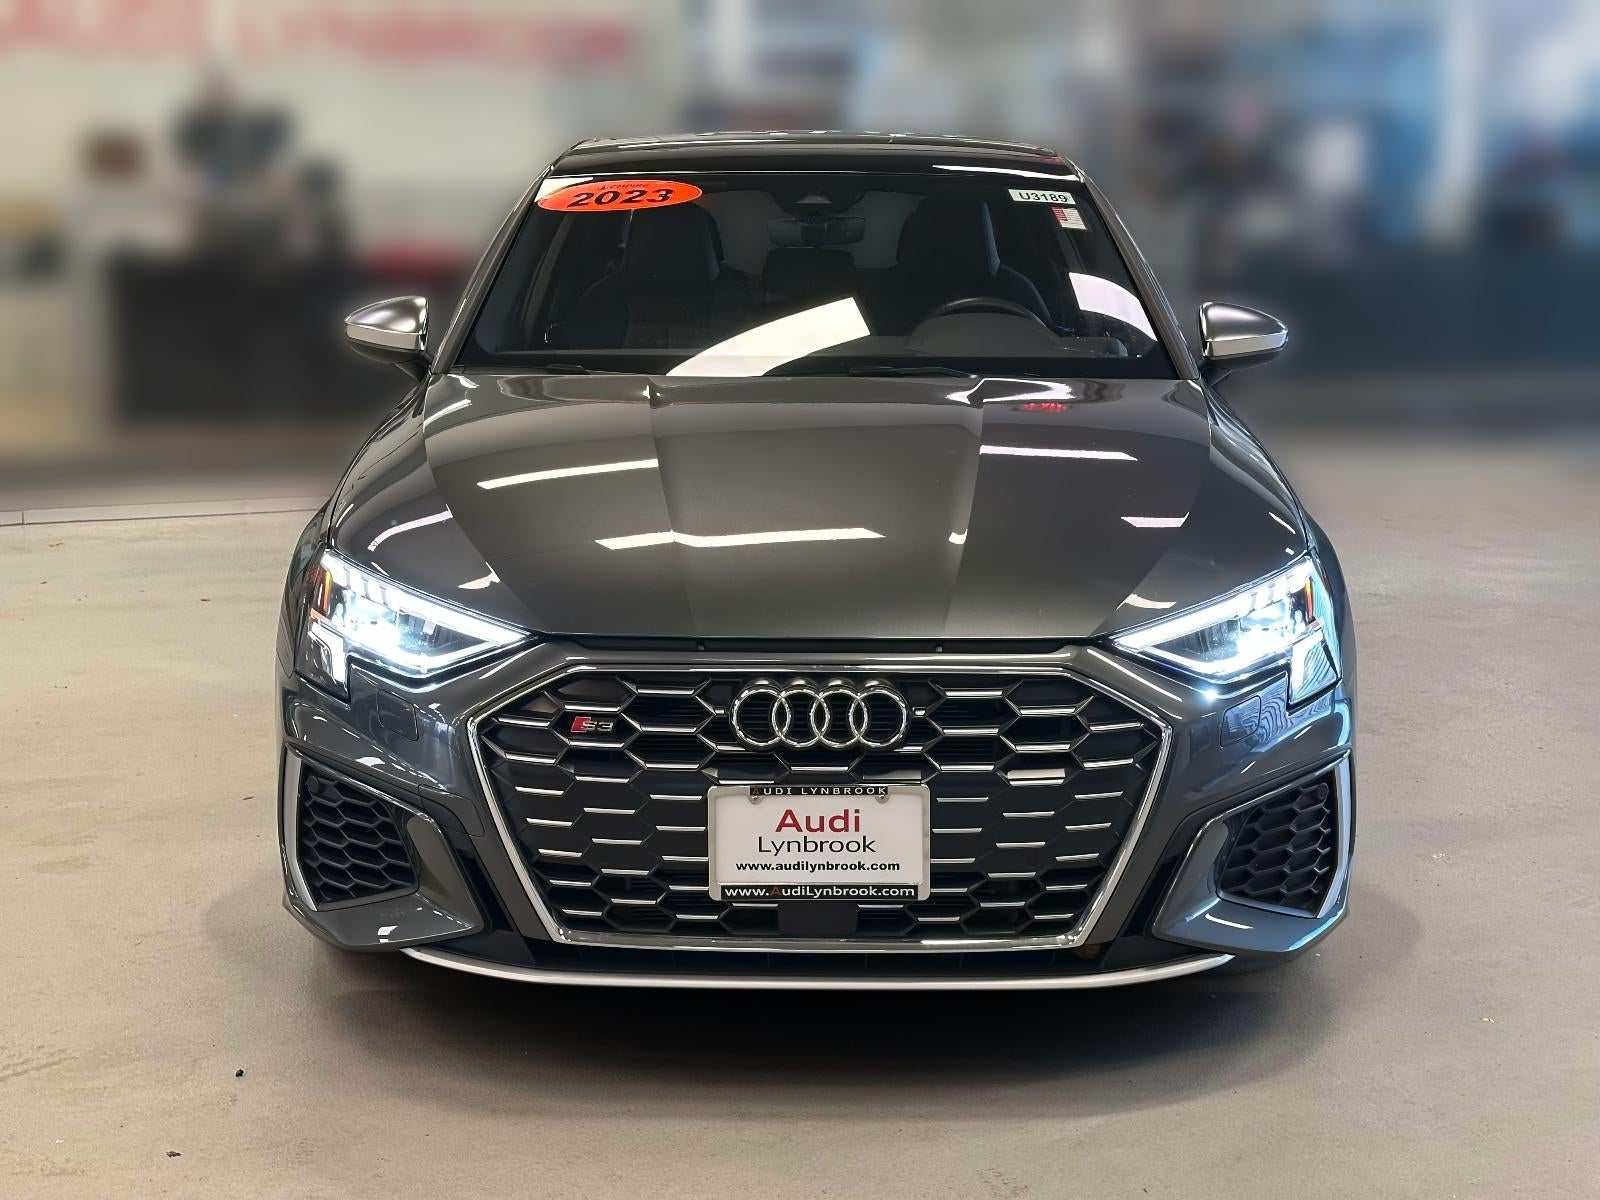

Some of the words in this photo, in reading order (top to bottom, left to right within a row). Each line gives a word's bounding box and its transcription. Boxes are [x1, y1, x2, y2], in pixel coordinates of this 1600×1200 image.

[567, 188, 674, 208] 2023
[1018, 192, 1068, 203] U3189
[751, 786, 793, 796] AUDI
[801, 786, 888, 796] LYNBROOK
[775, 809, 861, 833] Audi
[757, 835, 877, 857] Lynbrook
[735, 861, 901, 873] www.audilynbrook.com
[724, 886, 916, 899] www.AudiLynbrook.com
